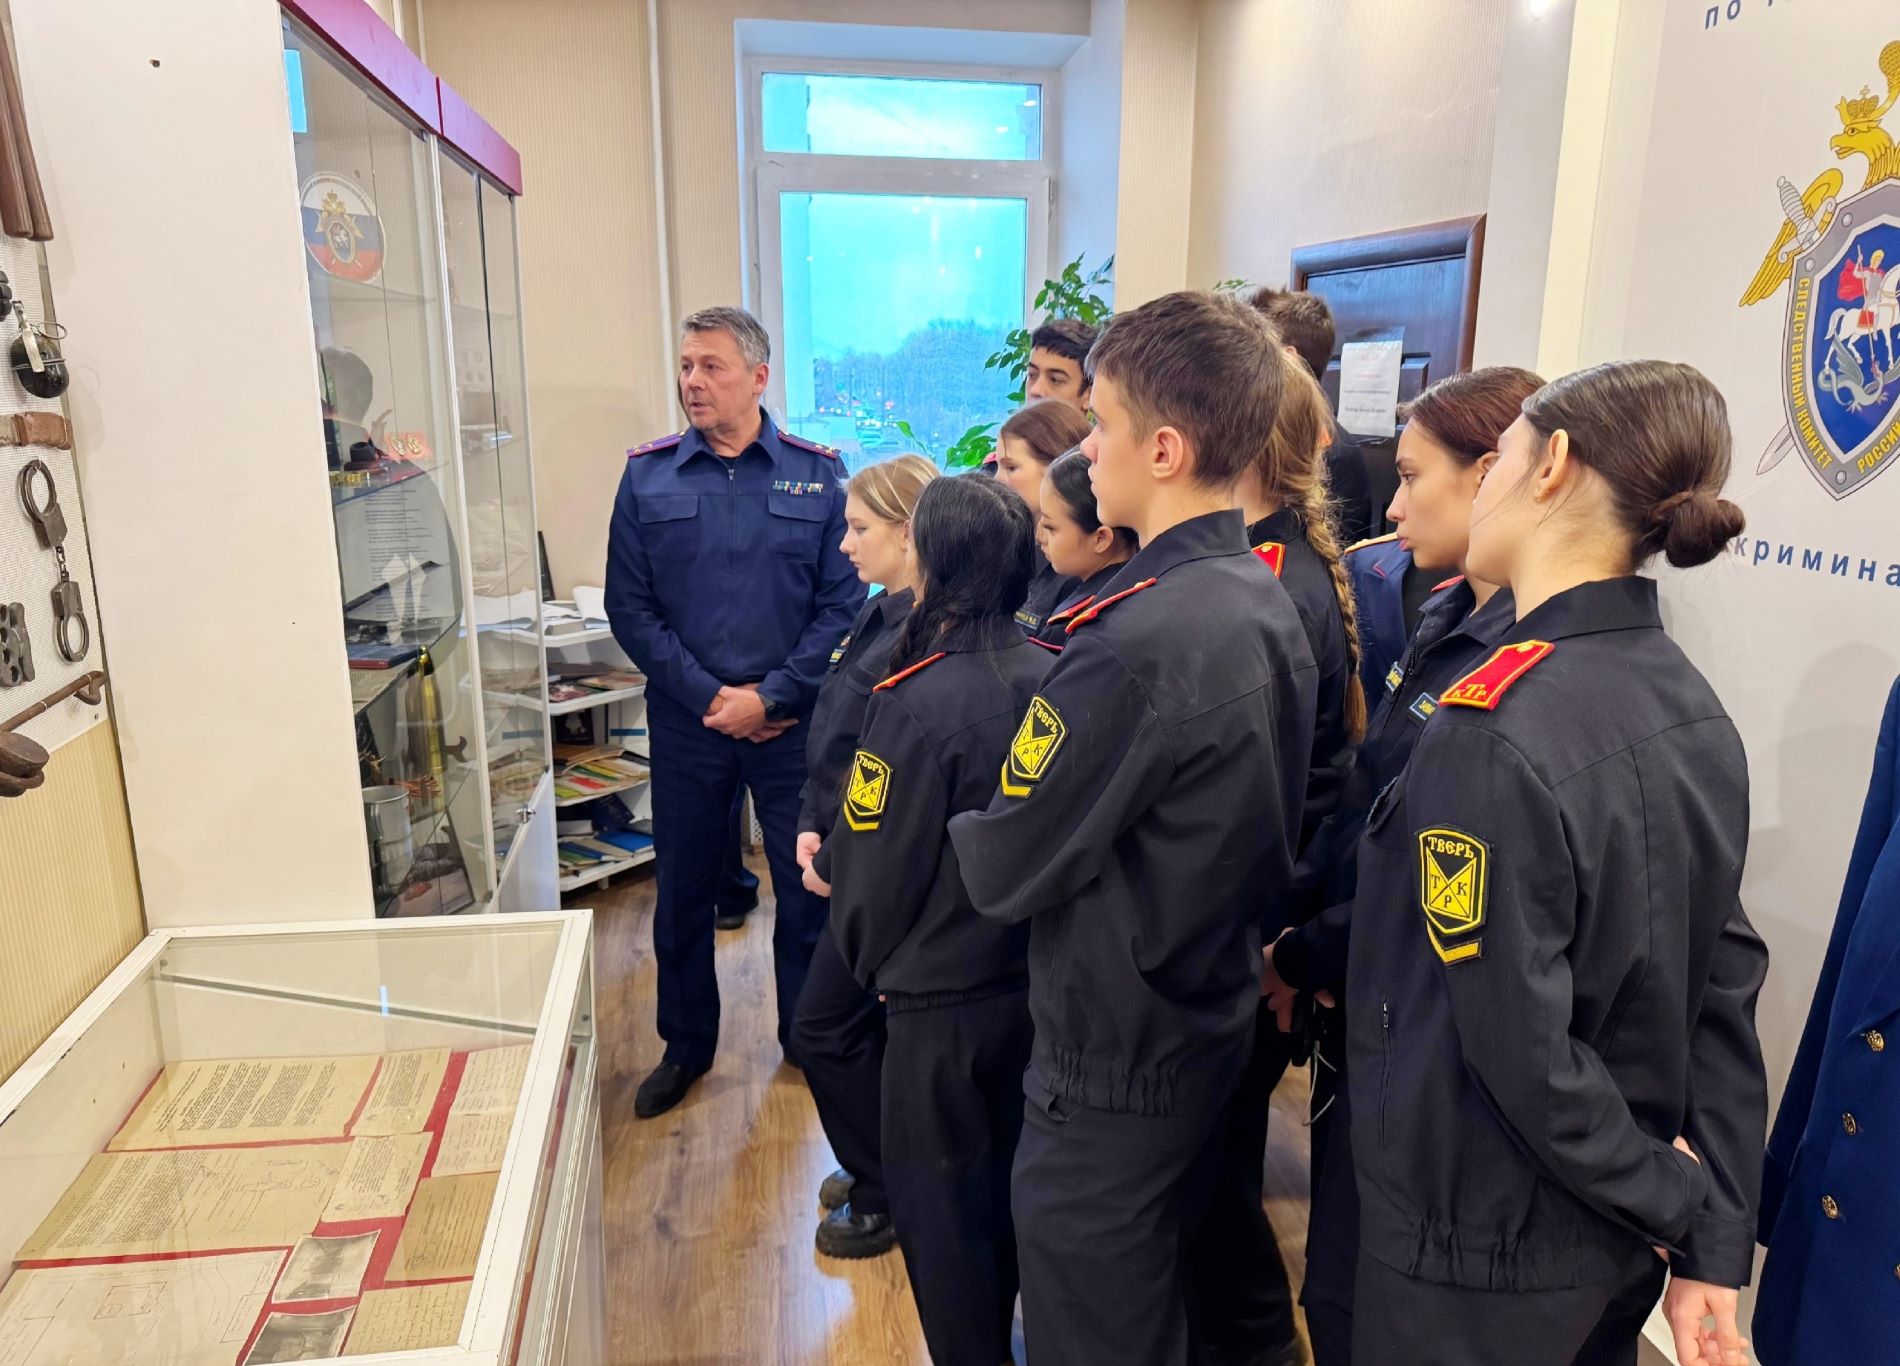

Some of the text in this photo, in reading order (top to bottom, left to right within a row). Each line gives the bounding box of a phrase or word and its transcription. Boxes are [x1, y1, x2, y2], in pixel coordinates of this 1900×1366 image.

[1705, 0, 1741, 30] по
[1791, 277, 1833, 469] СЛЕДСТВЕННЫЙ КОМИТЕТ
